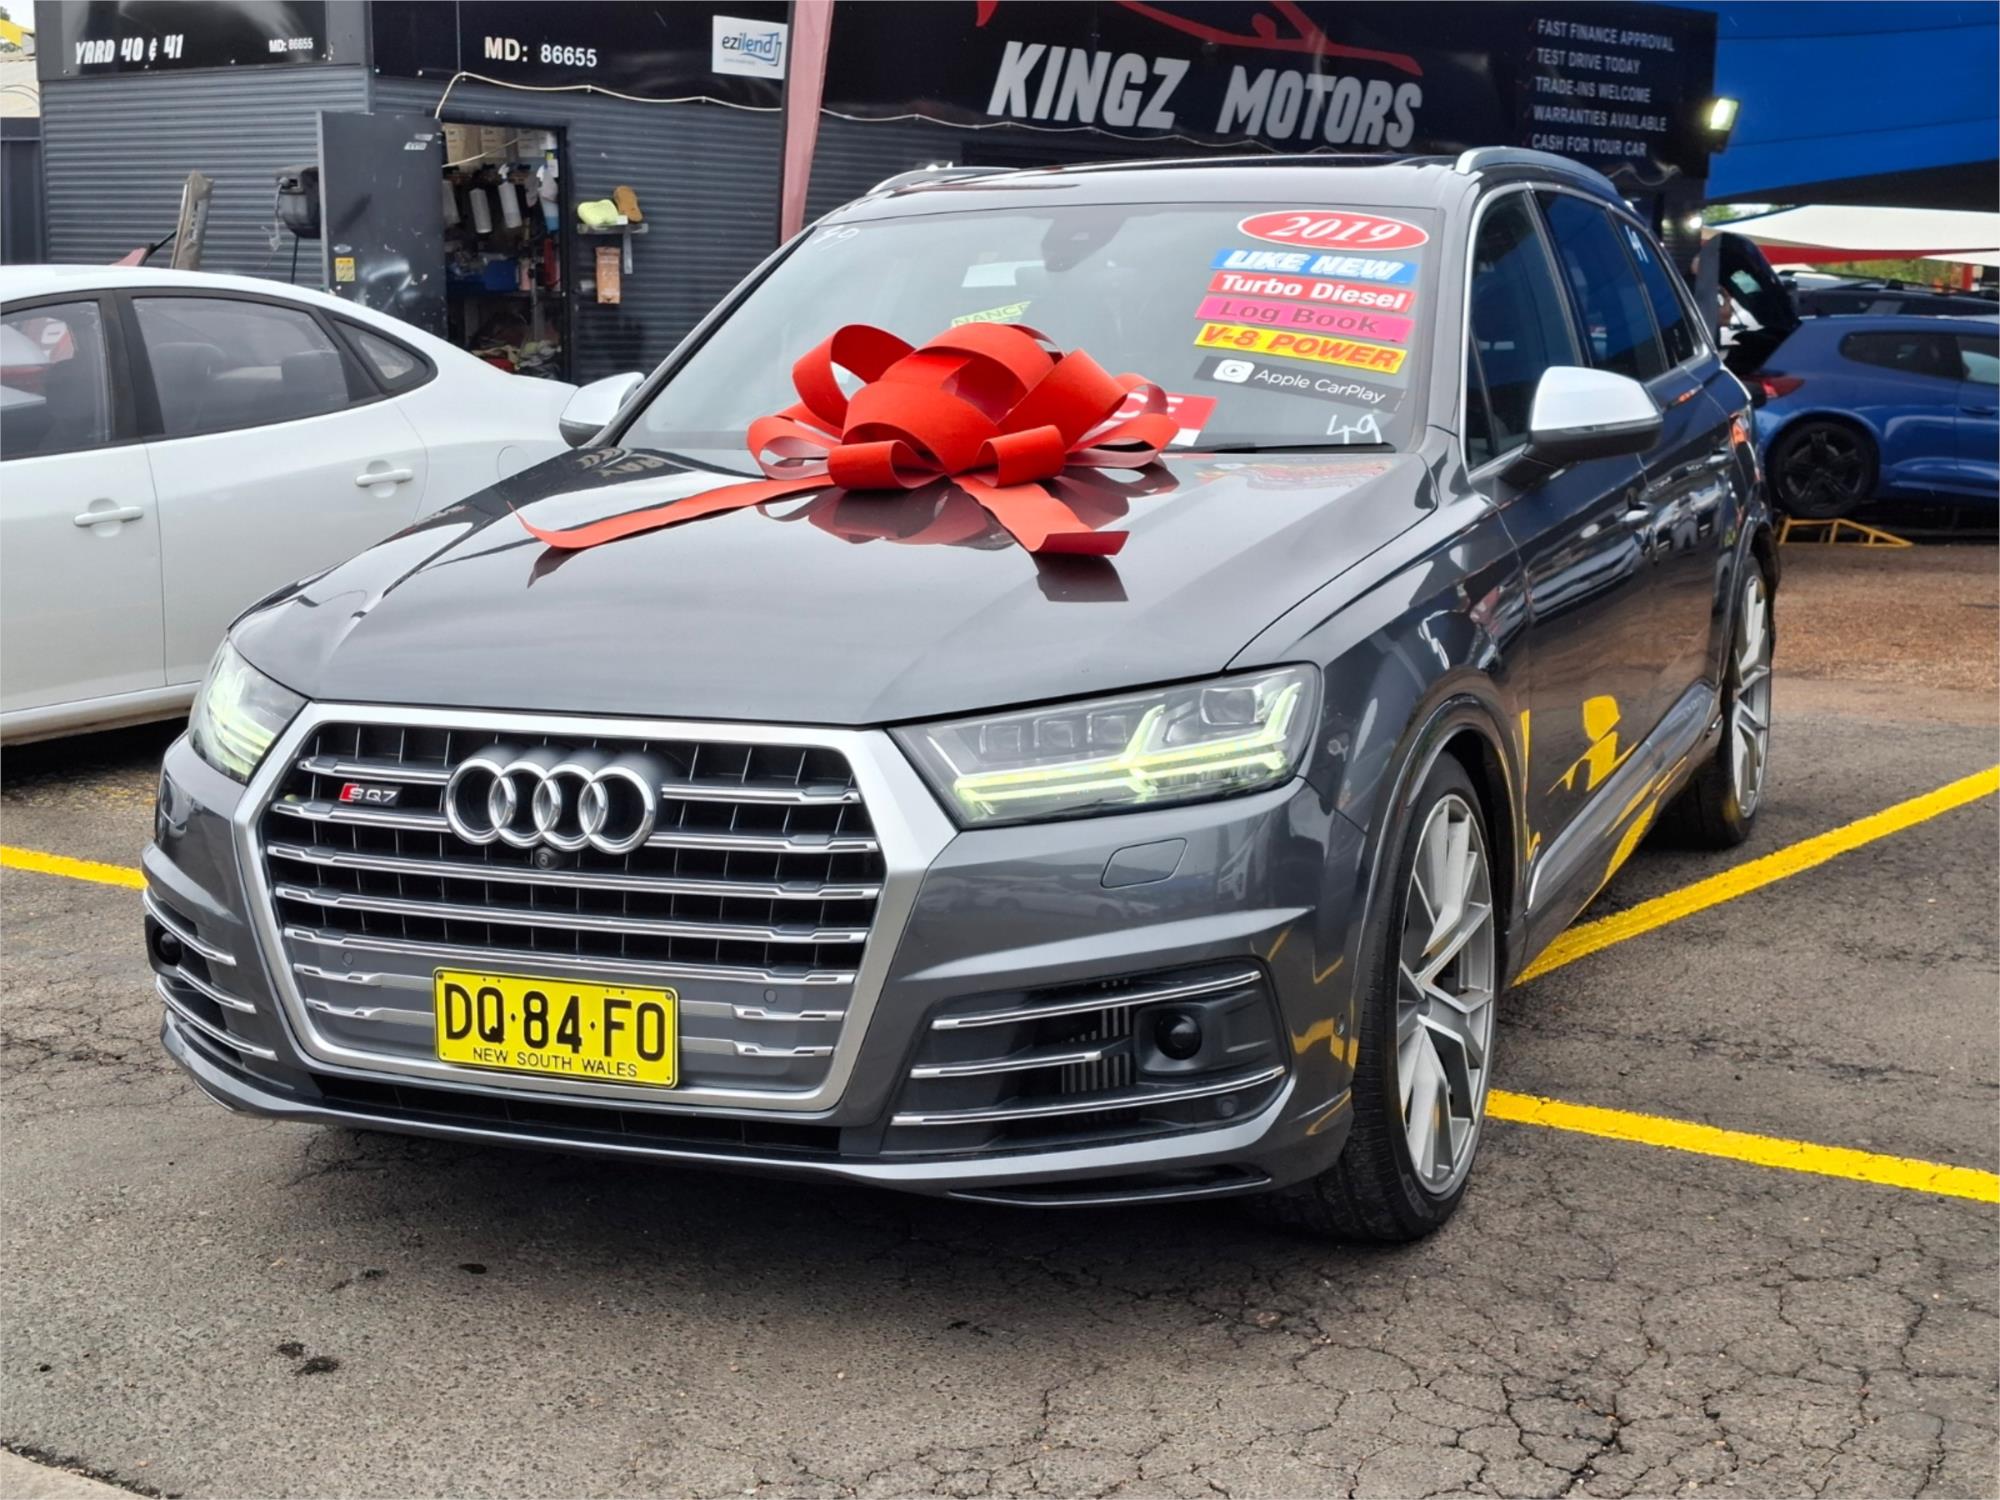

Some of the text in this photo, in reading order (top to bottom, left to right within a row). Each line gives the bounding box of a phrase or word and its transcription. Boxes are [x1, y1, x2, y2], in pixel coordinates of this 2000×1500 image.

[75, 34, 184, 64] YARD 40 & 41
[269, 39, 288, 53] MD:
[722, 32, 773, 54] ezilend
[1537, 19, 1675, 52] FAST FINANCE APPROVAL
[485, 36, 598, 68] MD: 86655
[1536, 48, 1641, 74] TEST DRIVE TODAY
[987, 41, 1422, 148] KINGZ MOTORS
[1535, 76, 1651, 103] TRADE-INS WELCOME
[1533, 105, 1667, 132] WARRANTIES AVAILABLE
[1532, 134, 1647, 157] CASH FOR YOUR CAR
[1266, 216, 1403, 244] 2019
[1223, 250, 1405, 280] LIKE NEW
[1221, 274, 1408, 310] Turbo Diesel
[1219, 301, 1379, 334] Log Book
[1203, 325, 1400, 369] V-8 POWER
[1254, 369, 1387, 405] Apple CarPlay
[348, 787, 398, 803] SQ7
[473, 1047, 637, 1077] NEW SOUTH WALES
